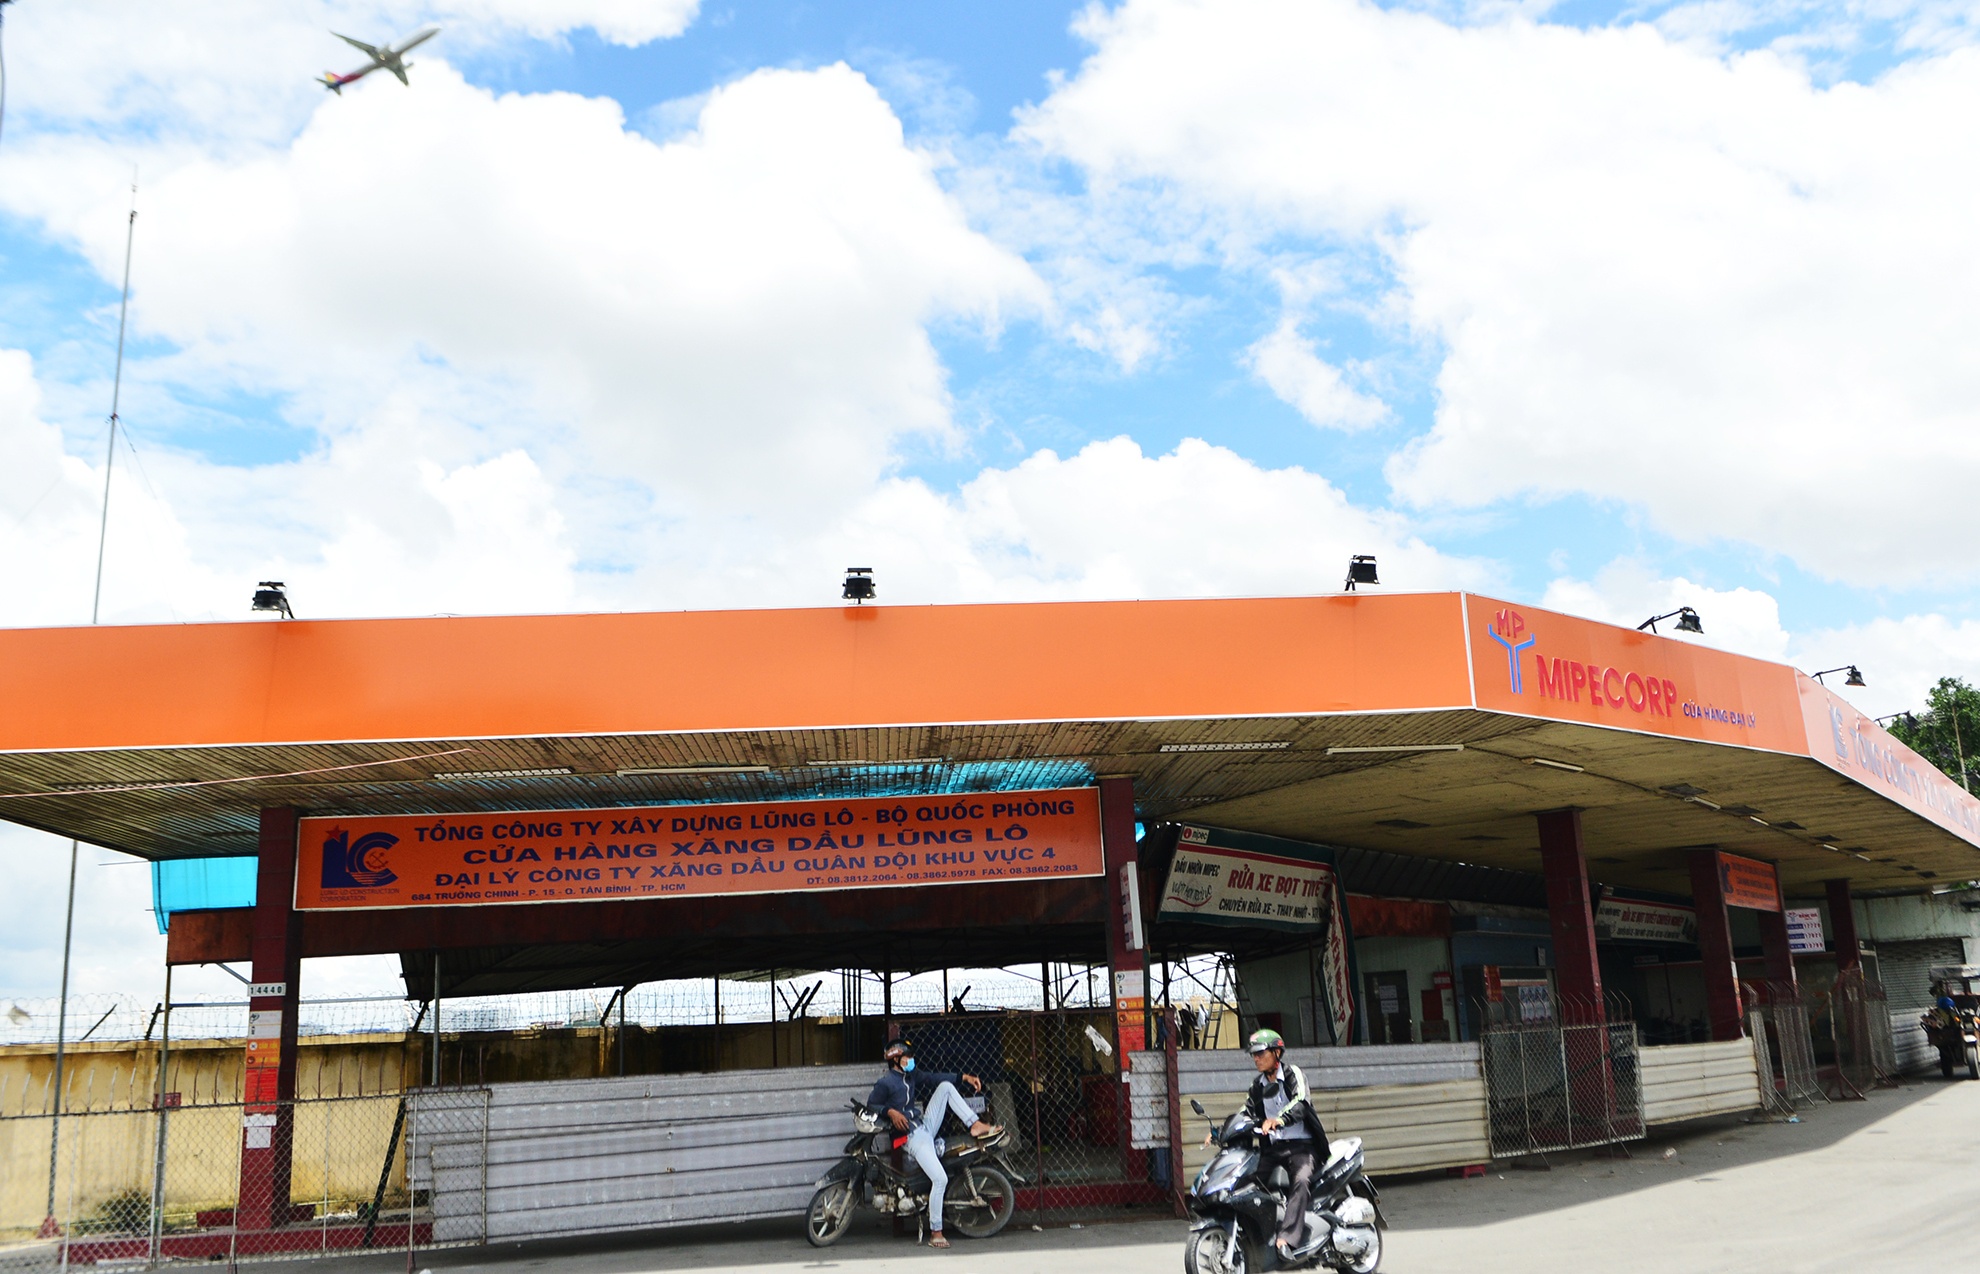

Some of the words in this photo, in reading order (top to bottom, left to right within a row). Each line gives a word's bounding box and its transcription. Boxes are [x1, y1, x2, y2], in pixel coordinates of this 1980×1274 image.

[1536, 654, 1677, 718] MIPECORP
[1682, 699, 1701, 719] CỬA
[1704, 703, 1728, 723] HÀNG
[414, 819, 484, 841] TỔNG
[492, 821, 562, 839] CÔNG
[570, 821, 602, 836] TY
[610, 816, 663, 834] XÂY
[671, 814, 742, 836] DỰNG
[751, 811, 816, 829] LŨNG
[824, 807, 854, 826] LÔ
[876, 805, 908, 827] BỘ
[916, 799, 984, 821] QUỐC
[992, 799, 1075, 818] PHÒNG
[463, 844, 542, 864] CỬA
[554, 841, 657, 861] HÀNG
[670, 838, 775, 856] XĂNG
[788, 830, 864, 850] DẦU
[877, 828, 973, 847] LŨNG
[986, 823, 1028, 842] LÔ
[435, 872, 480, 889] ĐẠI
[489, 868, 519, 884] LÝ
[528, 867, 601, 883] CÔNG
[609, 866, 641, 880] TY
[650, 861, 723, 879] XĂNG
[731, 857, 785, 875] DẦU
[794, 855, 866, 872] QUÂN
[873, 852, 917, 870] ĐỘI
[925, 851, 974, 865] KHU
[983, 847, 1034, 864] VỰC
[1042, 847, 1056, 859] 4
[828, 873, 897, 883] 08.3812.2064
[907, 870, 976, 880] 08.3862.5978
[982, 867, 1007, 876] FAX:
[1010, 864, 1078, 875] 08.3862.2083
[1202, 863, 1221, 877] MIPEC
[1228, 863, 1255, 890] RỬA
[1256, 873, 1274, 892] XE
[1275, 875, 1301, 898] BỌT
[411, 893, 431, 901] 684
[485, 889, 519, 899] CHINH
[543, 888, 555, 896] 15
[580, 885, 602, 894] TÂN
[661, 883, 686, 891] HCM
[1219, 897, 1248, 912] CHUYÊN
[1262, 902, 1272, 915] XE
[1276, 904, 1294, 918] THAY
